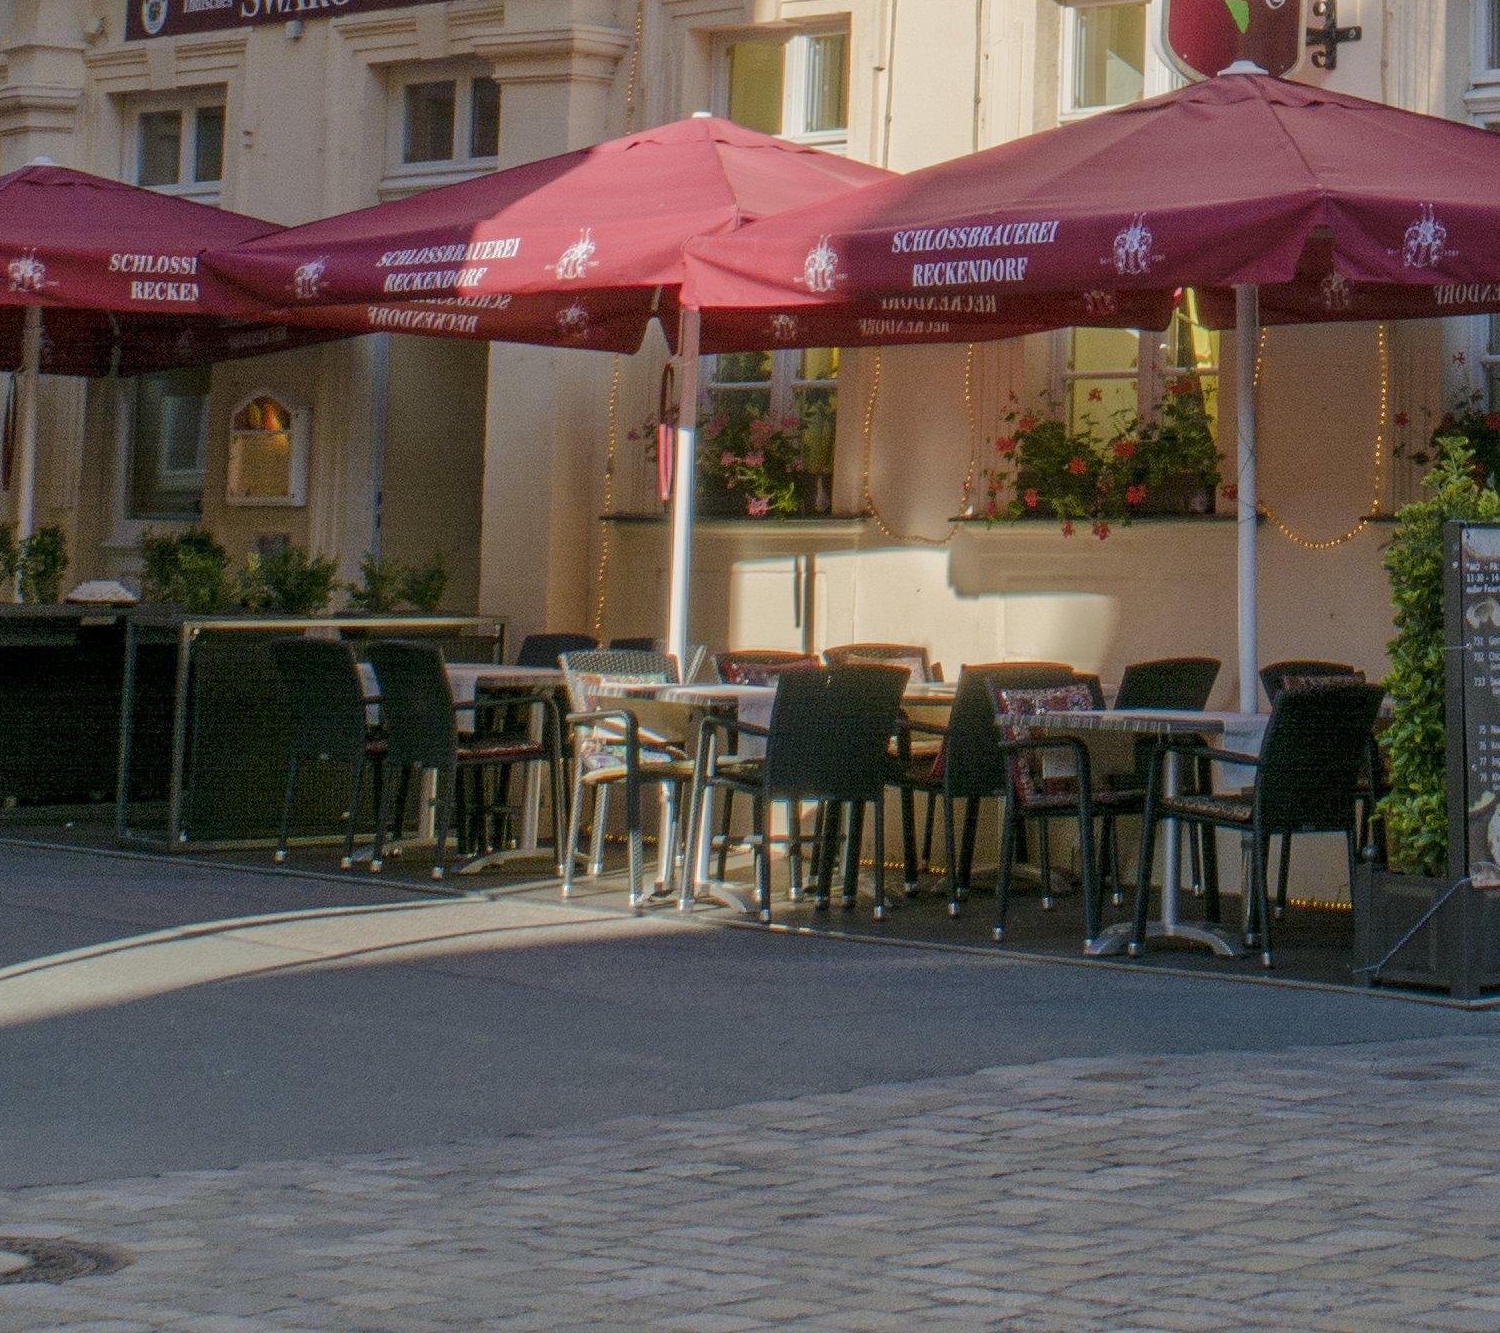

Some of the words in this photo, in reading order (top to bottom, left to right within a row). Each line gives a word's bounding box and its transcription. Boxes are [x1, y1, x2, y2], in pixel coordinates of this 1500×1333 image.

[891, 219, 1060, 255] SCHLOSSBRAUEREI
[375, 238, 521, 268] SCHLOSSBRAUEREI
[383, 267, 488, 293] RECKENDORF
[912, 256, 1029, 288] RECKENDORF
